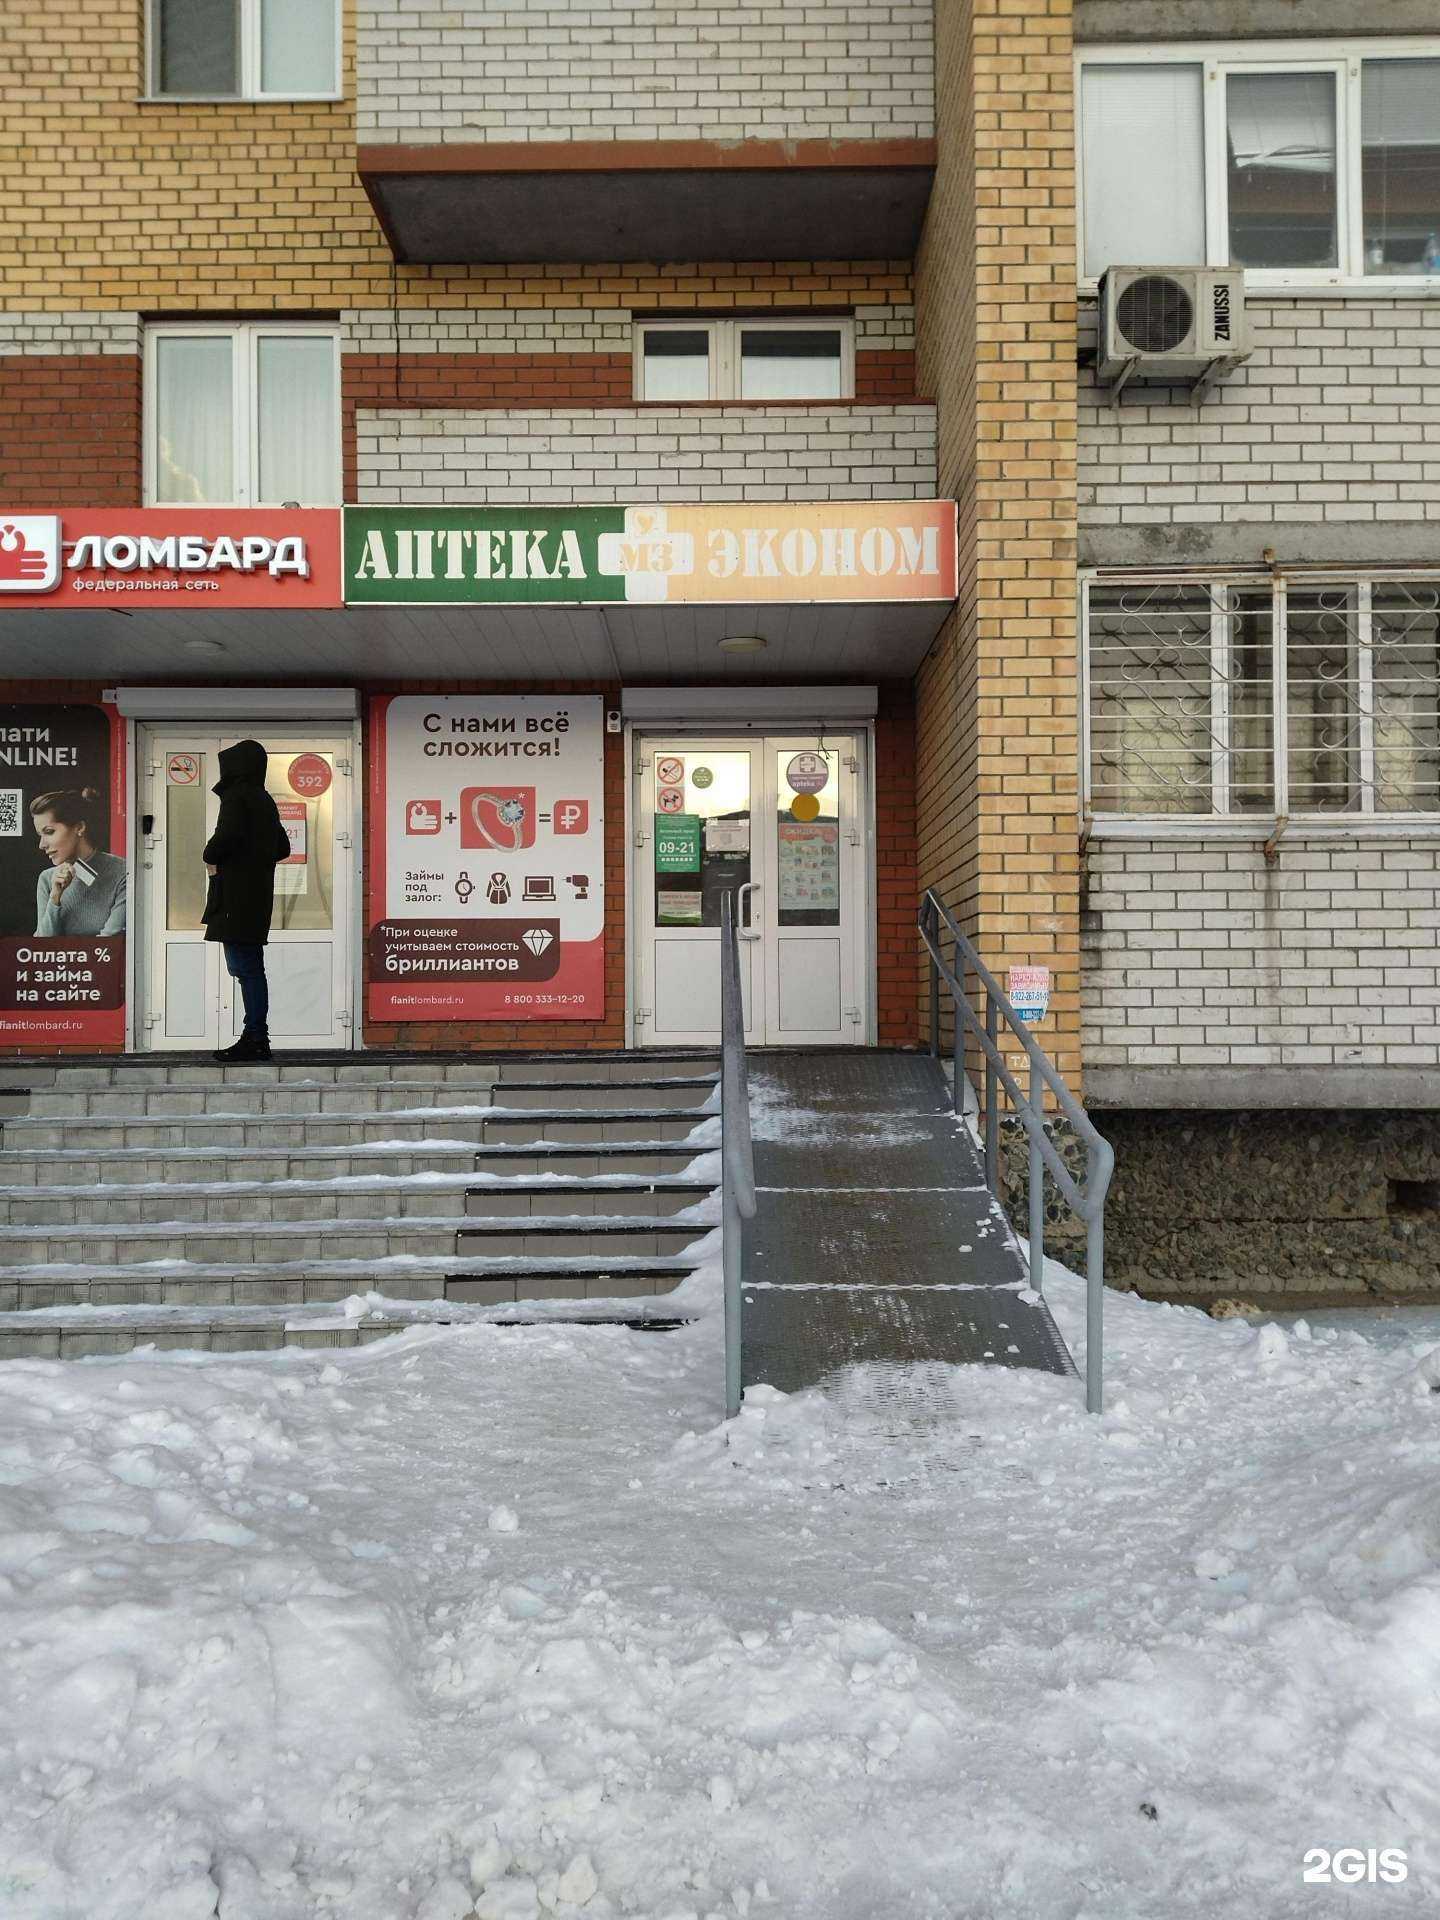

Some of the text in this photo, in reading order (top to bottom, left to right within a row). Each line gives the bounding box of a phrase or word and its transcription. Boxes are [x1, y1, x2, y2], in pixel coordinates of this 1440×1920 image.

[1213, 284, 1230, 341] ZANUSSI
[67, 535, 309, 577] ЛОМБАРД
[354, 530, 587, 580] АПТЕКА
[707, 526, 940, 578] ЭКОНОМ
[72, 576, 219, 592] федеральная сеть
[423, 711, 570, 733] С нами всё
[423, 738, 561, 757] сложится!
[297, 776, 323, 788] 392
[659, 841, 695, 854] 09-21
[405, 870, 444, 881] Займы
[405, 883, 428, 893] под
[405, 894, 442, 902] залог:
[413, 928, 458, 939] оценке
[16, 947, 111, 963] Оплата %
[385, 942, 520, 952] учитываем стоимость
[385, 954, 520, 974] бриллиантов
[16, 965, 92, 982] и займа
[16, 984, 101, 1001] на сайте
[391, 995, 464, 1005] fianitlombard.ru
[504, 994, 511, 1004] 8
[514, 994, 533, 1004] 800
